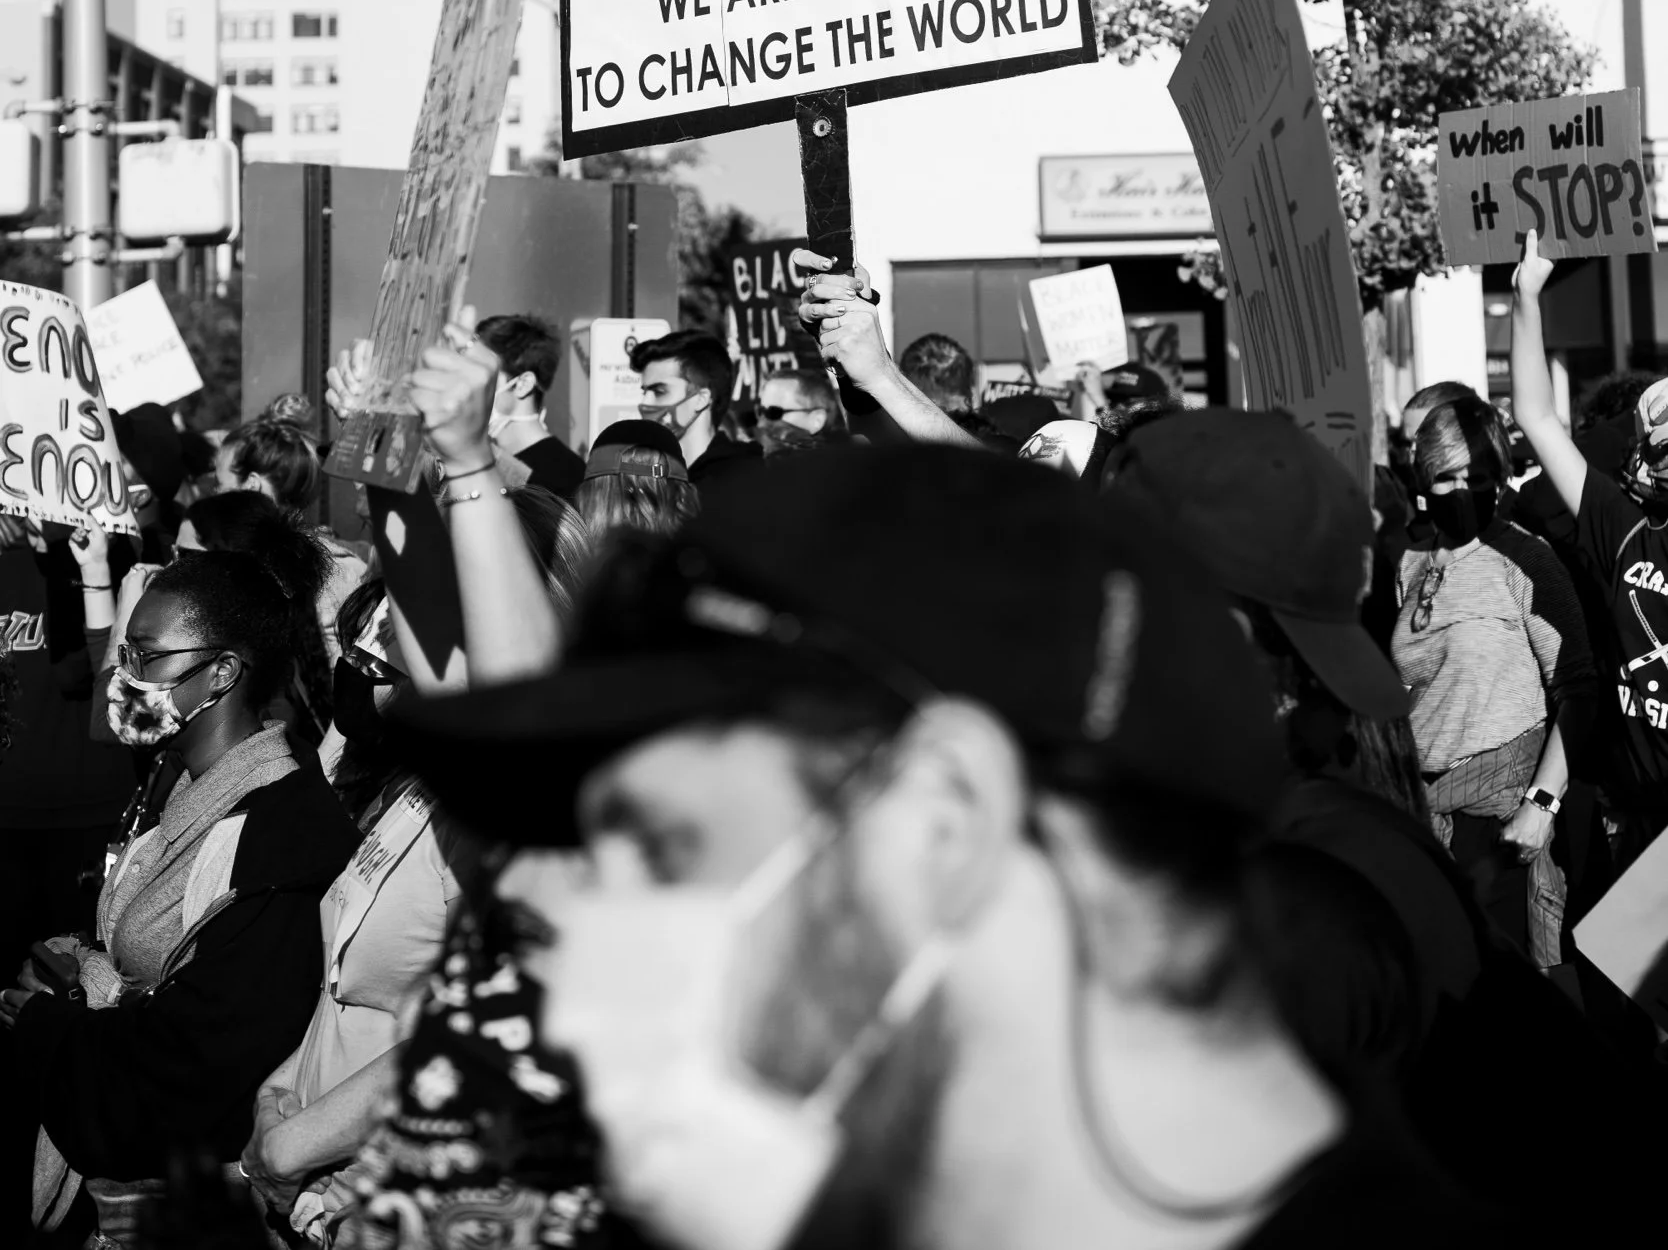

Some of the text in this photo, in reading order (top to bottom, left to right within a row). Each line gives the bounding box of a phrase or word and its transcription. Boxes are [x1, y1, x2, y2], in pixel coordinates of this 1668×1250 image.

[576, 63, 625, 112] TO
[638, 27, 816, 101] CHANGE
[825, 10, 895, 68] THE
[1450, 105, 1604, 158] when will
[1471, 159, 1645, 245] it STOP?
[60, 398, 104, 442] IS
